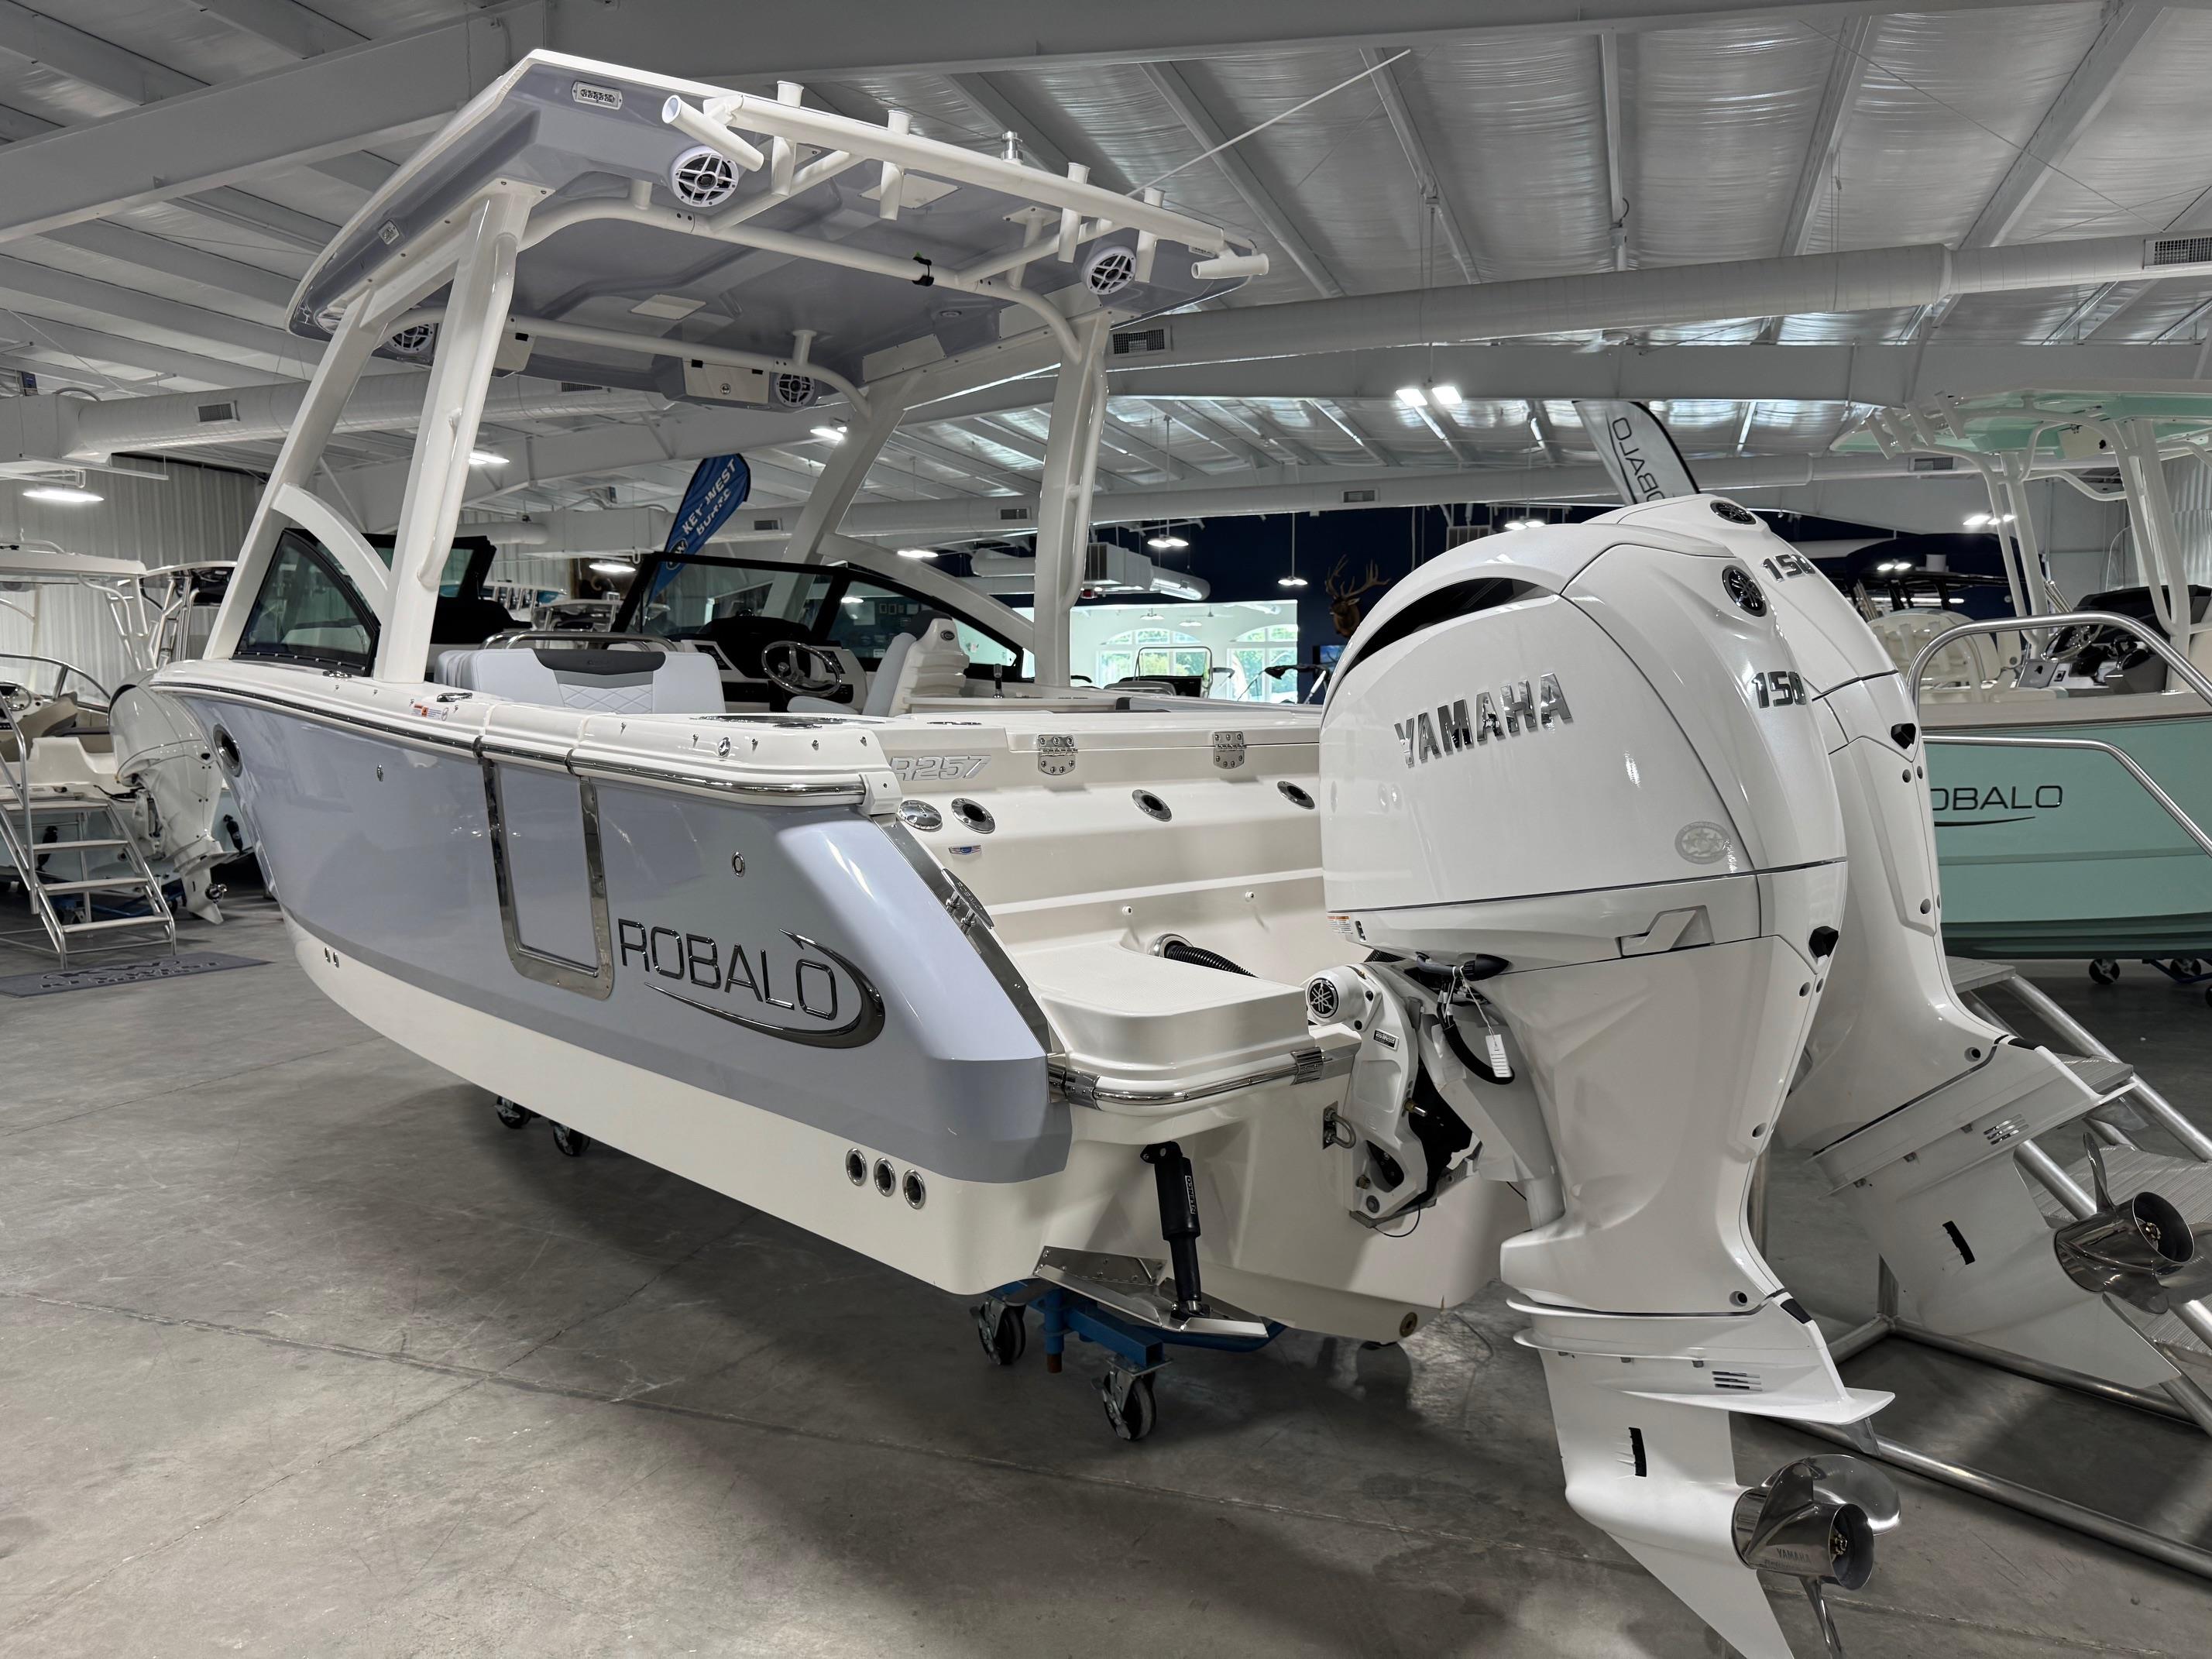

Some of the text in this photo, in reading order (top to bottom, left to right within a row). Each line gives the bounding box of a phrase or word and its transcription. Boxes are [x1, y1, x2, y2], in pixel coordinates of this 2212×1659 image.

[682, 459, 736, 534] KEY WEST
[1762, 554, 1815, 582] 150
[1752, 671, 1807, 709] 150
[1394, 673, 1571, 766] YAMAHA
[891, 755, 992, 781] R257
[1931, 785, 2063, 811] OBALO
[618, 918, 838, 1020] ROBALO
[1776, 1548, 1812, 1564] YAMAHA
